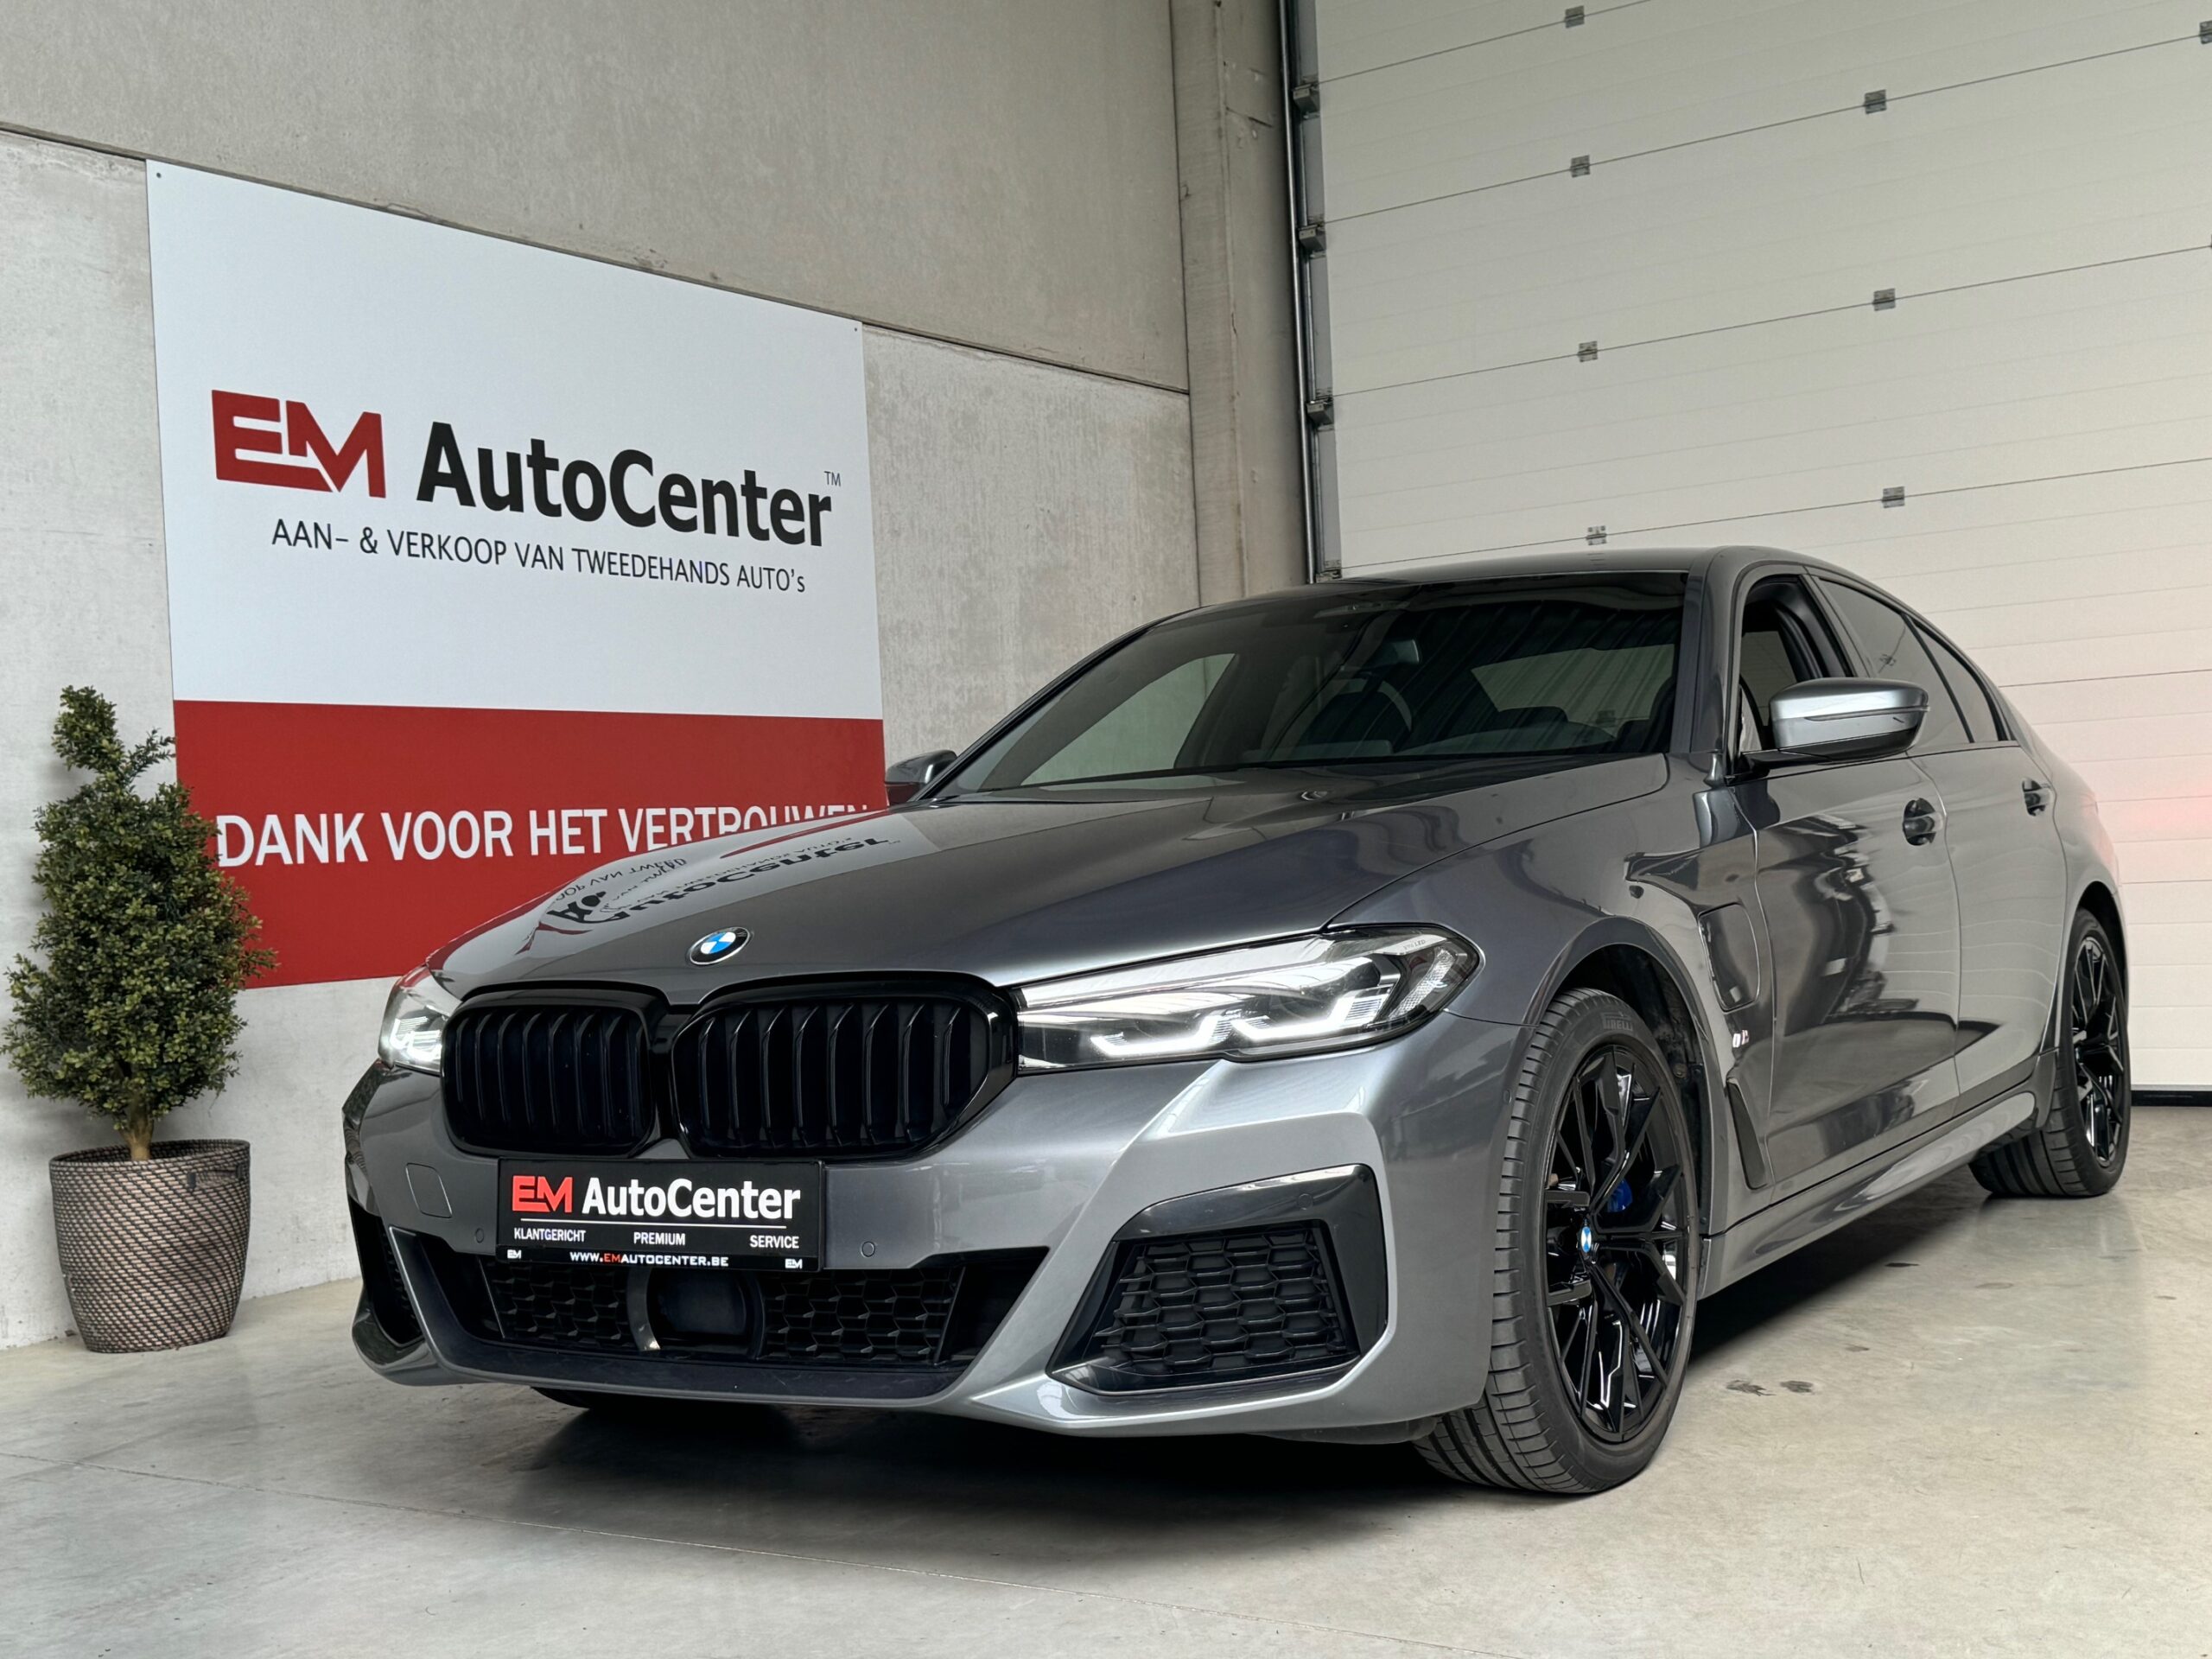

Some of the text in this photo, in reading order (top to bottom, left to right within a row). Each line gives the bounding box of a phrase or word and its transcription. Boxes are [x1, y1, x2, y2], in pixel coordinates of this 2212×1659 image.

[212, 390, 386, 499] EM
[416, 421, 832, 547] AutoCenter
[271, 518, 805, 593] AAN- & VERKOOP VAN TWEEDEHANDS AUTO's
[216, 804, 867, 868] DANK VOOR HET VERTRO
[512, 1175, 800, 1219] EM AutoCenter
[507, 1249, 521, 1260] EM
[513, 1227, 799, 1249] KLANTGERICHT PREMIUM SERVICE
[569, 1251, 728, 1267] WWW.EMAUTOCENTER.BE
[785, 1258, 803, 1269] EM
